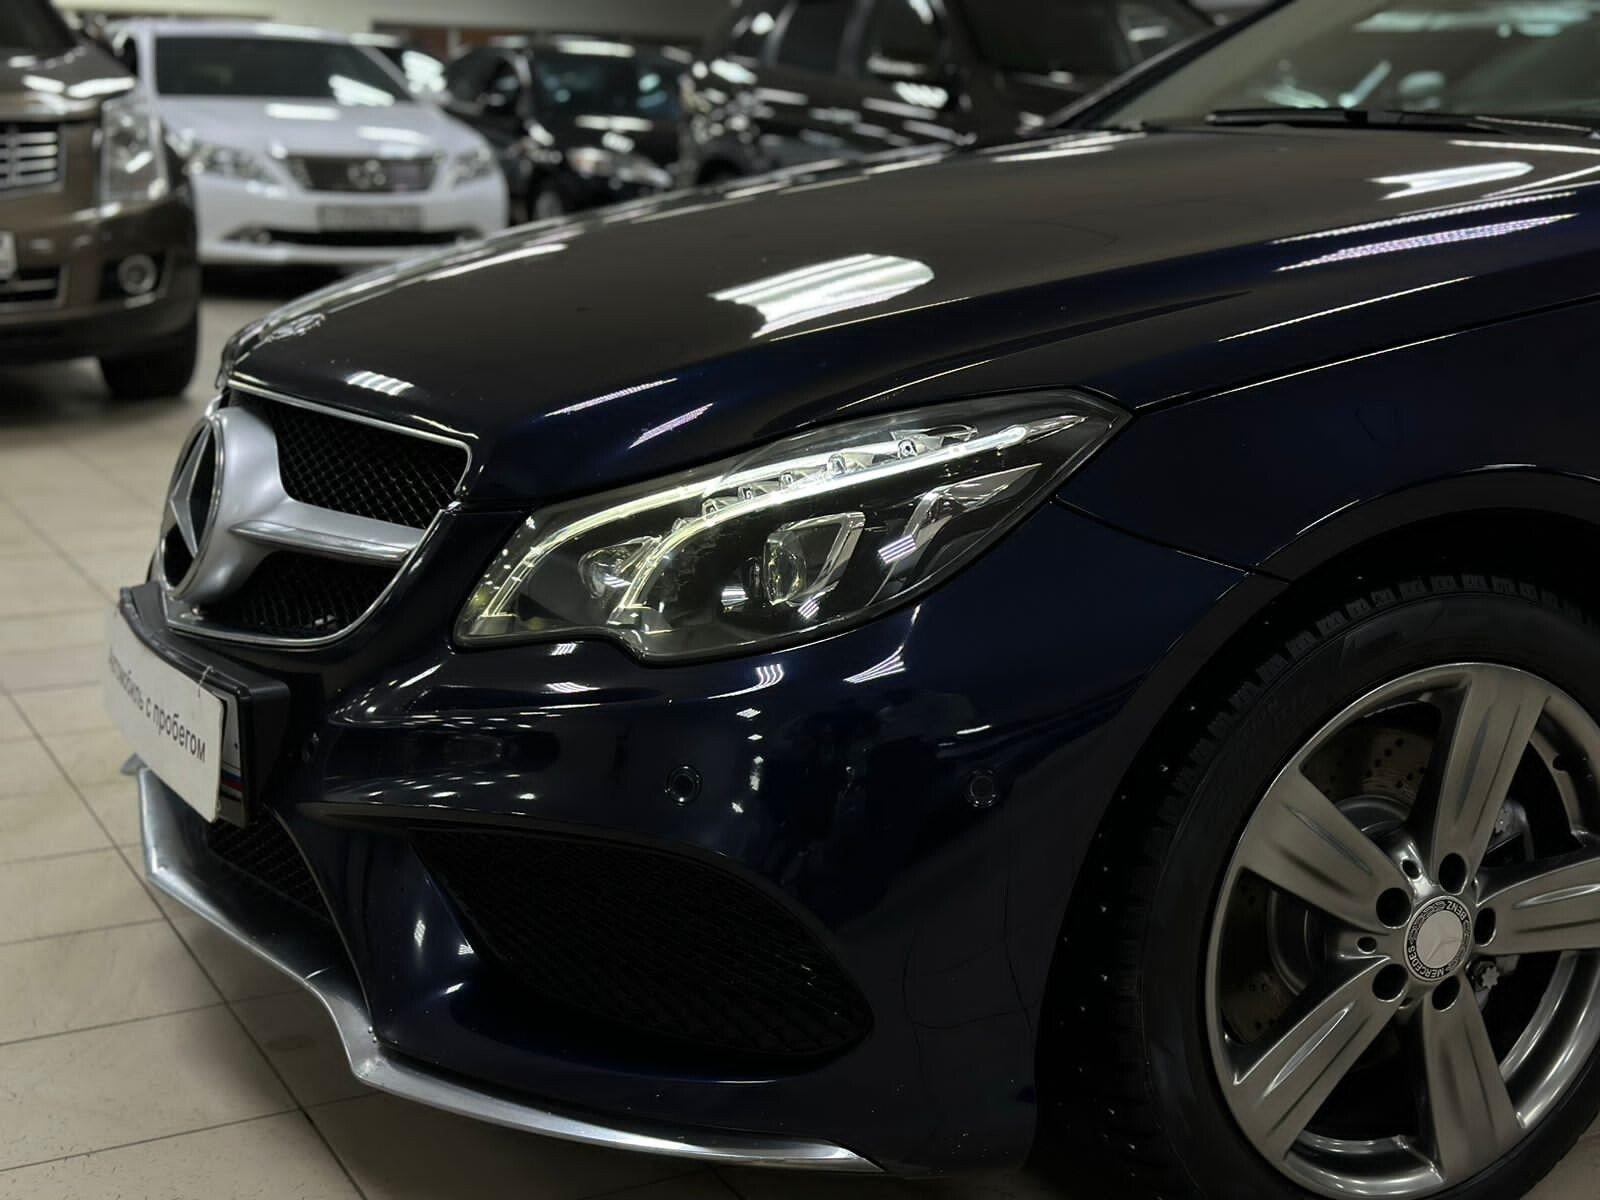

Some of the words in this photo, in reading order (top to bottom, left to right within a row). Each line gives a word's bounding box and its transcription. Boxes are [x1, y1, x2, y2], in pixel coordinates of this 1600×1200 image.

[145, 697, 151, 718] с
[153, 703, 206, 763] пробегом
[1446, 901, 1467, 921] BENZ
[1408, 945, 1445, 978] MERCEDES
